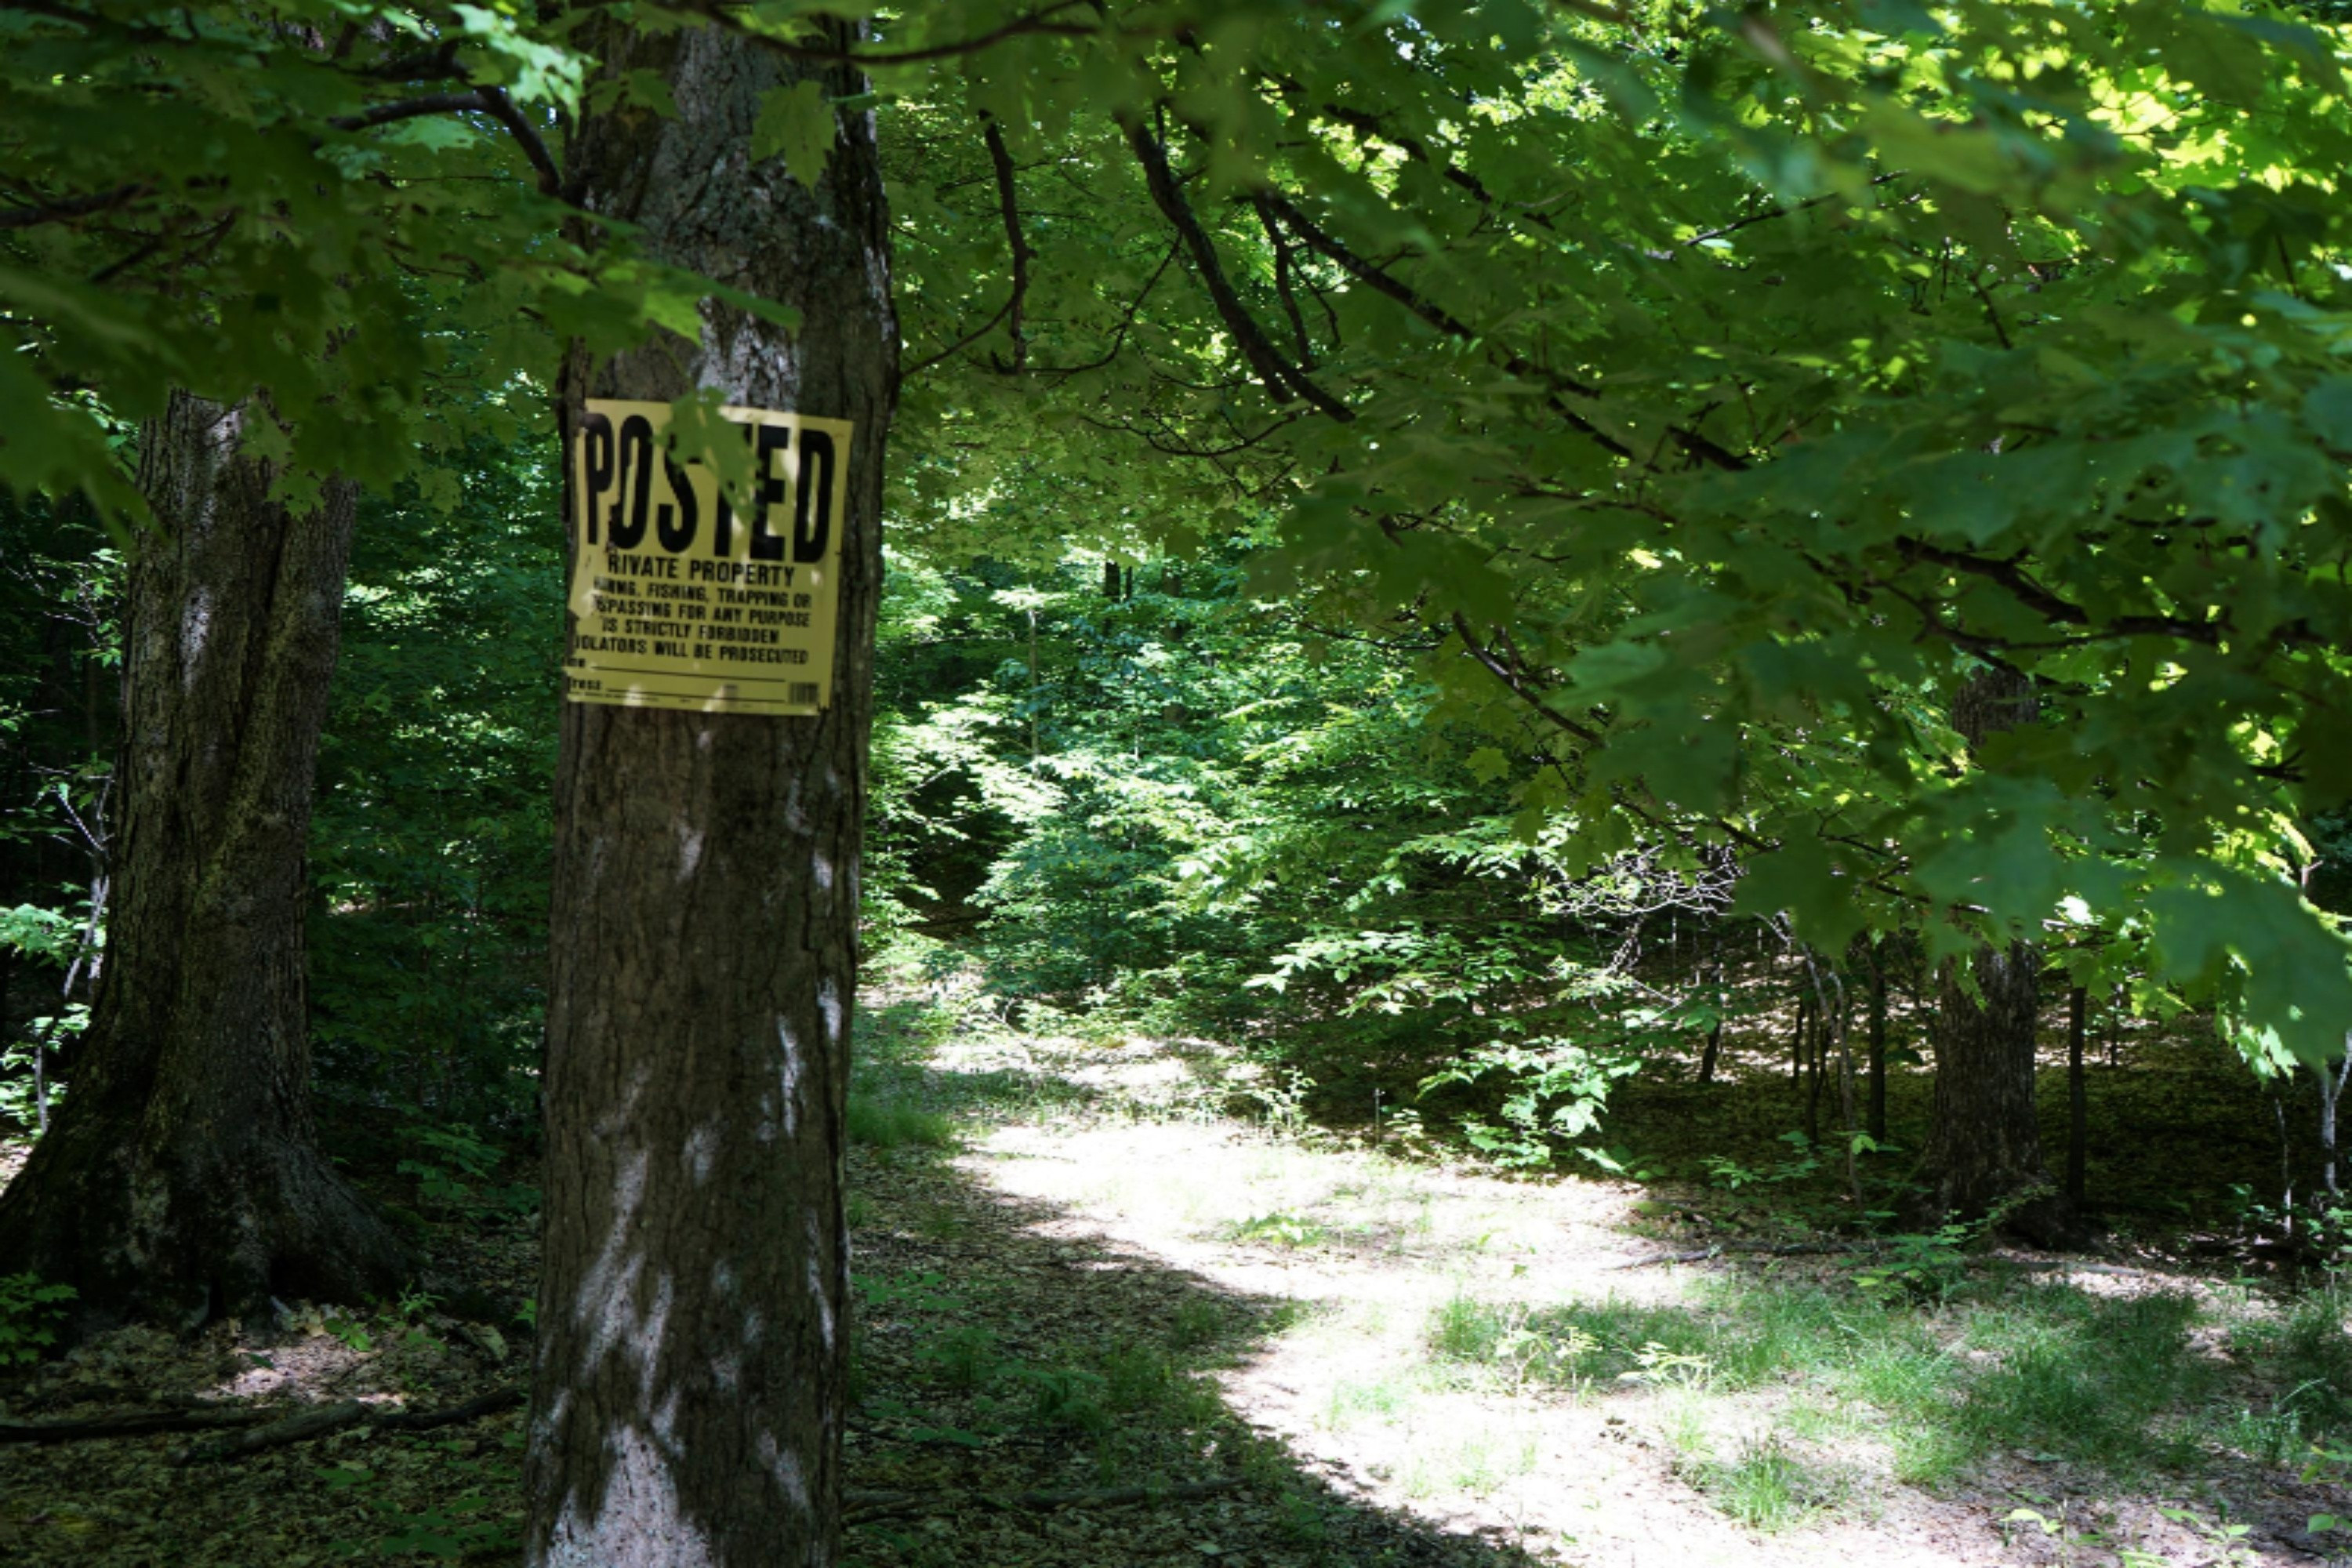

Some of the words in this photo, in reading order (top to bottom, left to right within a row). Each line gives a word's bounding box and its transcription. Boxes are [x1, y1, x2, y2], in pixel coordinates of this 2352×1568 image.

[690, 559, 794, 587] PROPERTY
[717, 587, 788, 608] TRAPPING
[793, 593, 811, 608] OR
[678, 603, 706, 620] FOR
[713, 606, 742, 623] ANY
[749, 609, 811, 628] PURPOSE
[626, 619, 691, 638] STRICTLY
[699, 625, 779, 644] FORBIDDEN
[655, 641, 688, 658] WILL
[694, 644, 712, 659] BE
[719, 646, 809, 665] PROSECUTED
